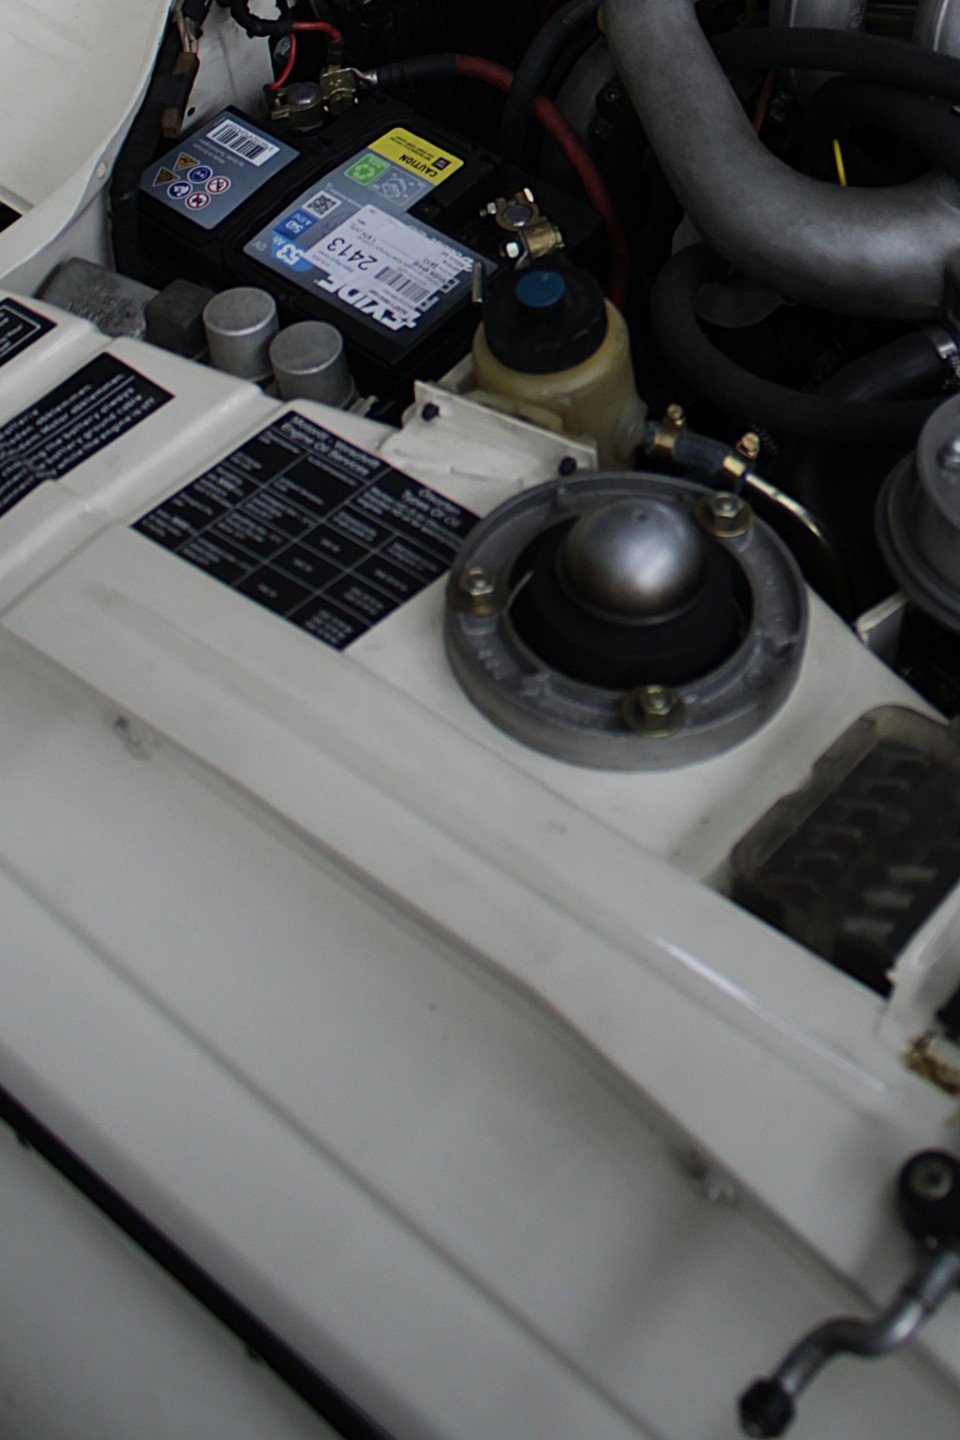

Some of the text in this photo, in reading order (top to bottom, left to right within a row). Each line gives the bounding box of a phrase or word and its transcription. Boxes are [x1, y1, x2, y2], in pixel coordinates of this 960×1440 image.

[399, 154, 438, 177] CAUTION
[275, 243, 305, 266] 53
[327, 237, 378, 271] 2413
[62, 413, 100, 440] battery
[100, 387, 135, 414] always
[100, 415, 131, 440] engine
[46, 437, 84, 464] battery
[83, 412, 116, 439] ground
[117, 394, 142, 415] cable
[281, 422, 314, 445] Engine
[314, 442, 330, 453] Oil
[401, 489, 430, 511] Types
